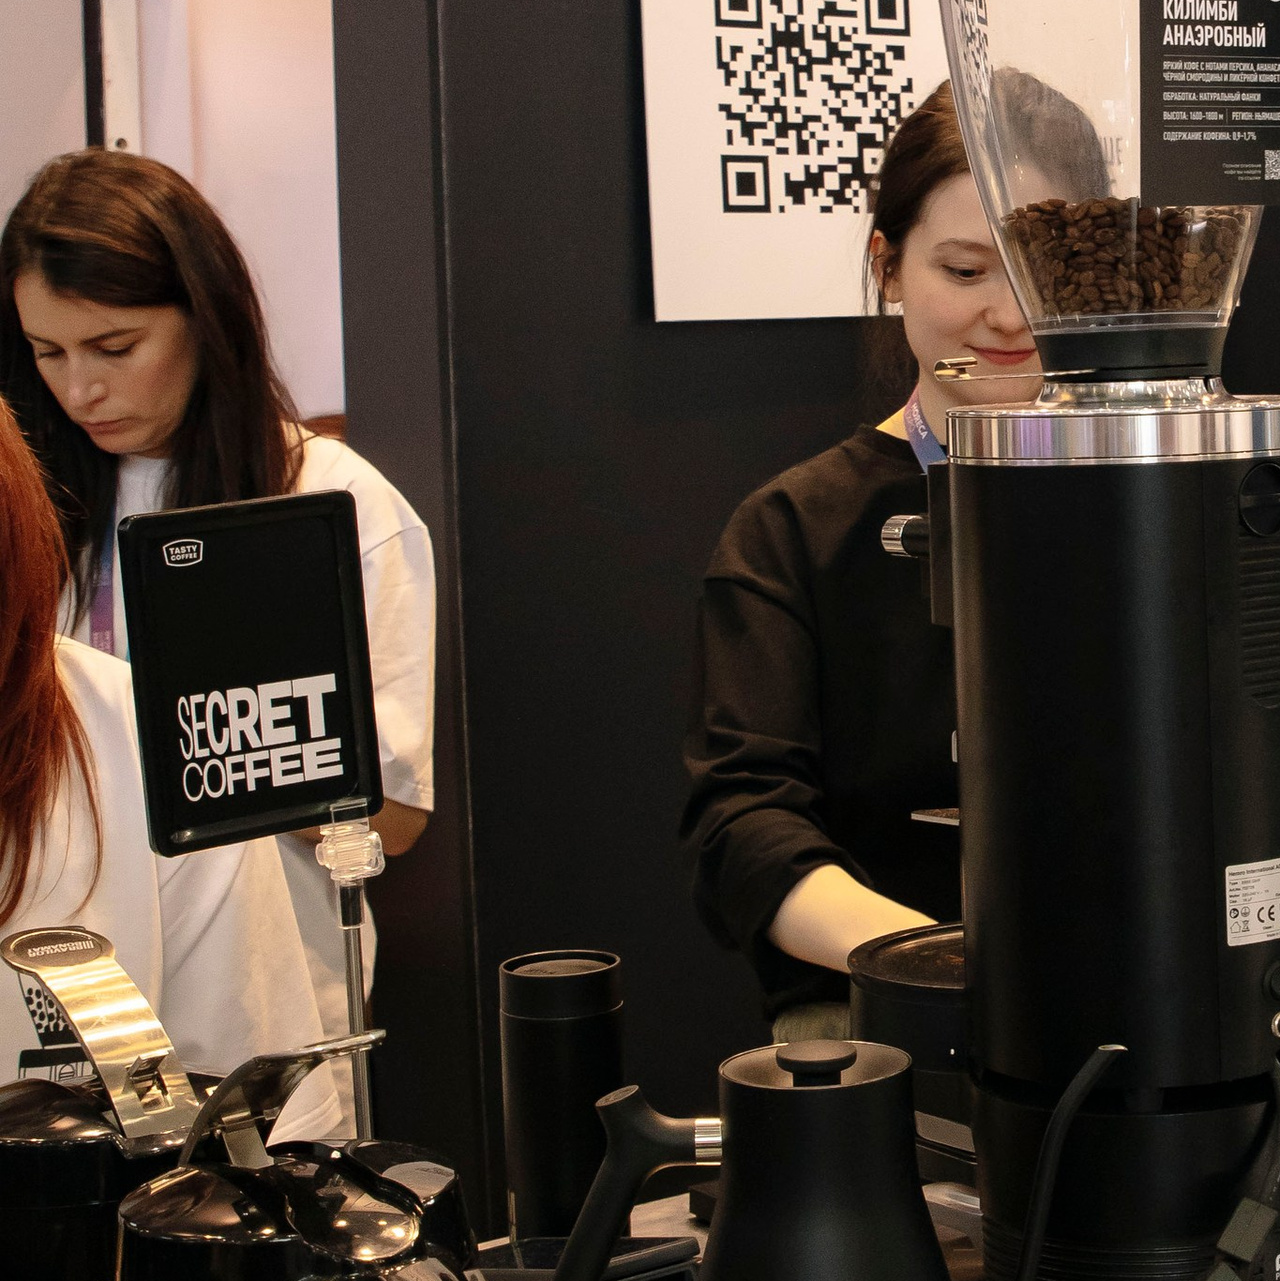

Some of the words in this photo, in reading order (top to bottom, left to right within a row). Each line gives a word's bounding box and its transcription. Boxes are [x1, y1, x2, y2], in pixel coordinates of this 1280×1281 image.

[1163, 22, 1266, 48] АНАЭРОБНЫЙ
[910, 402, 929, 440] HORECA
[169, 544, 197, 555] TASTY
[170, 552, 198, 562] COFFEE
[177, 673, 337, 761] SECRET
[183, 737, 344, 802] COFFEE
